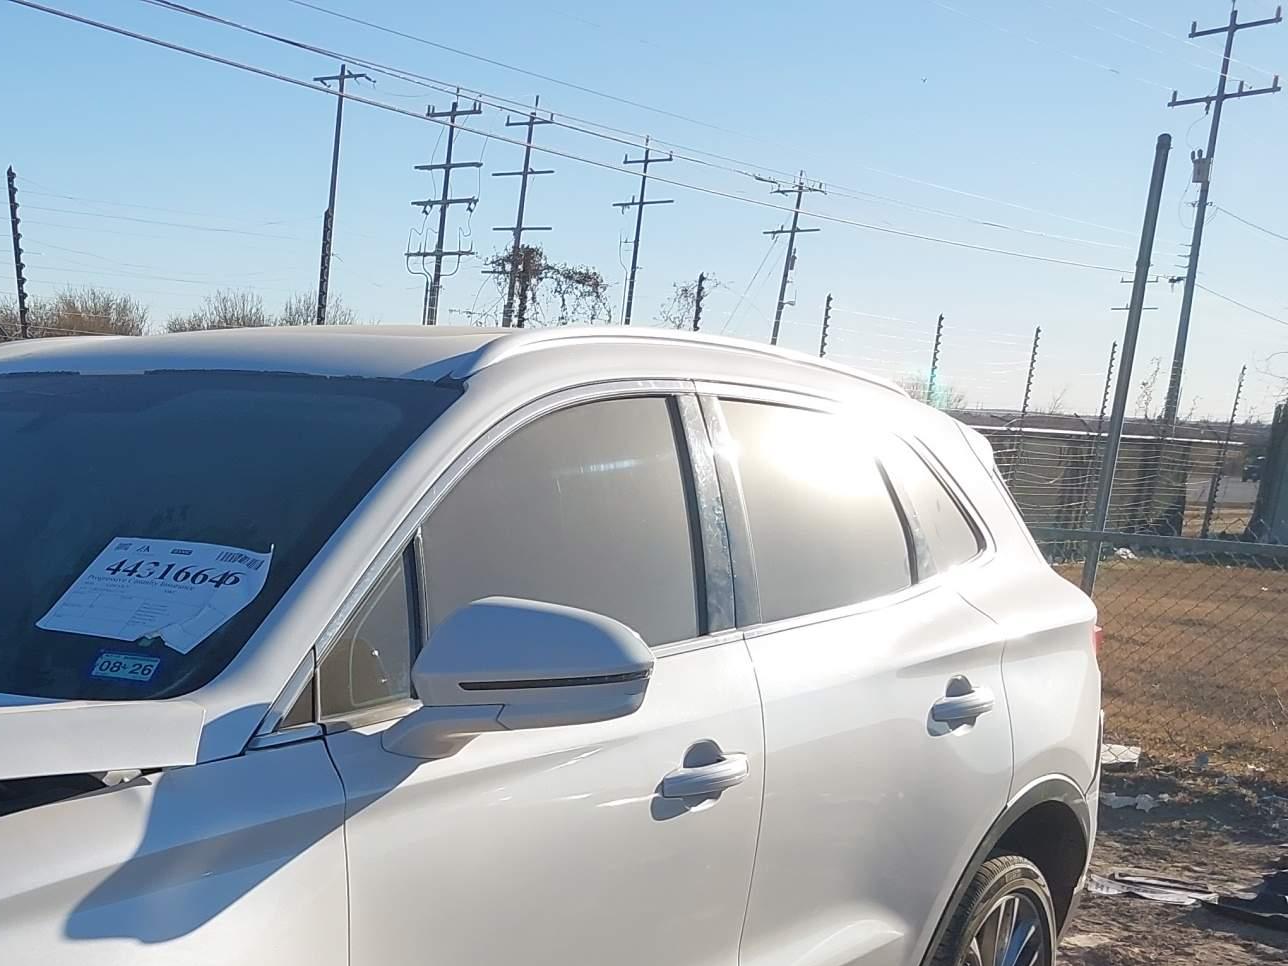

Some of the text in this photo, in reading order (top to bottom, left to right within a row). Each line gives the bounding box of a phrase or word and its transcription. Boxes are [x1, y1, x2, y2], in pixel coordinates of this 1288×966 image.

[105, 558, 247, 589] 44316646
[99, 660, 153, 676] 08 26
